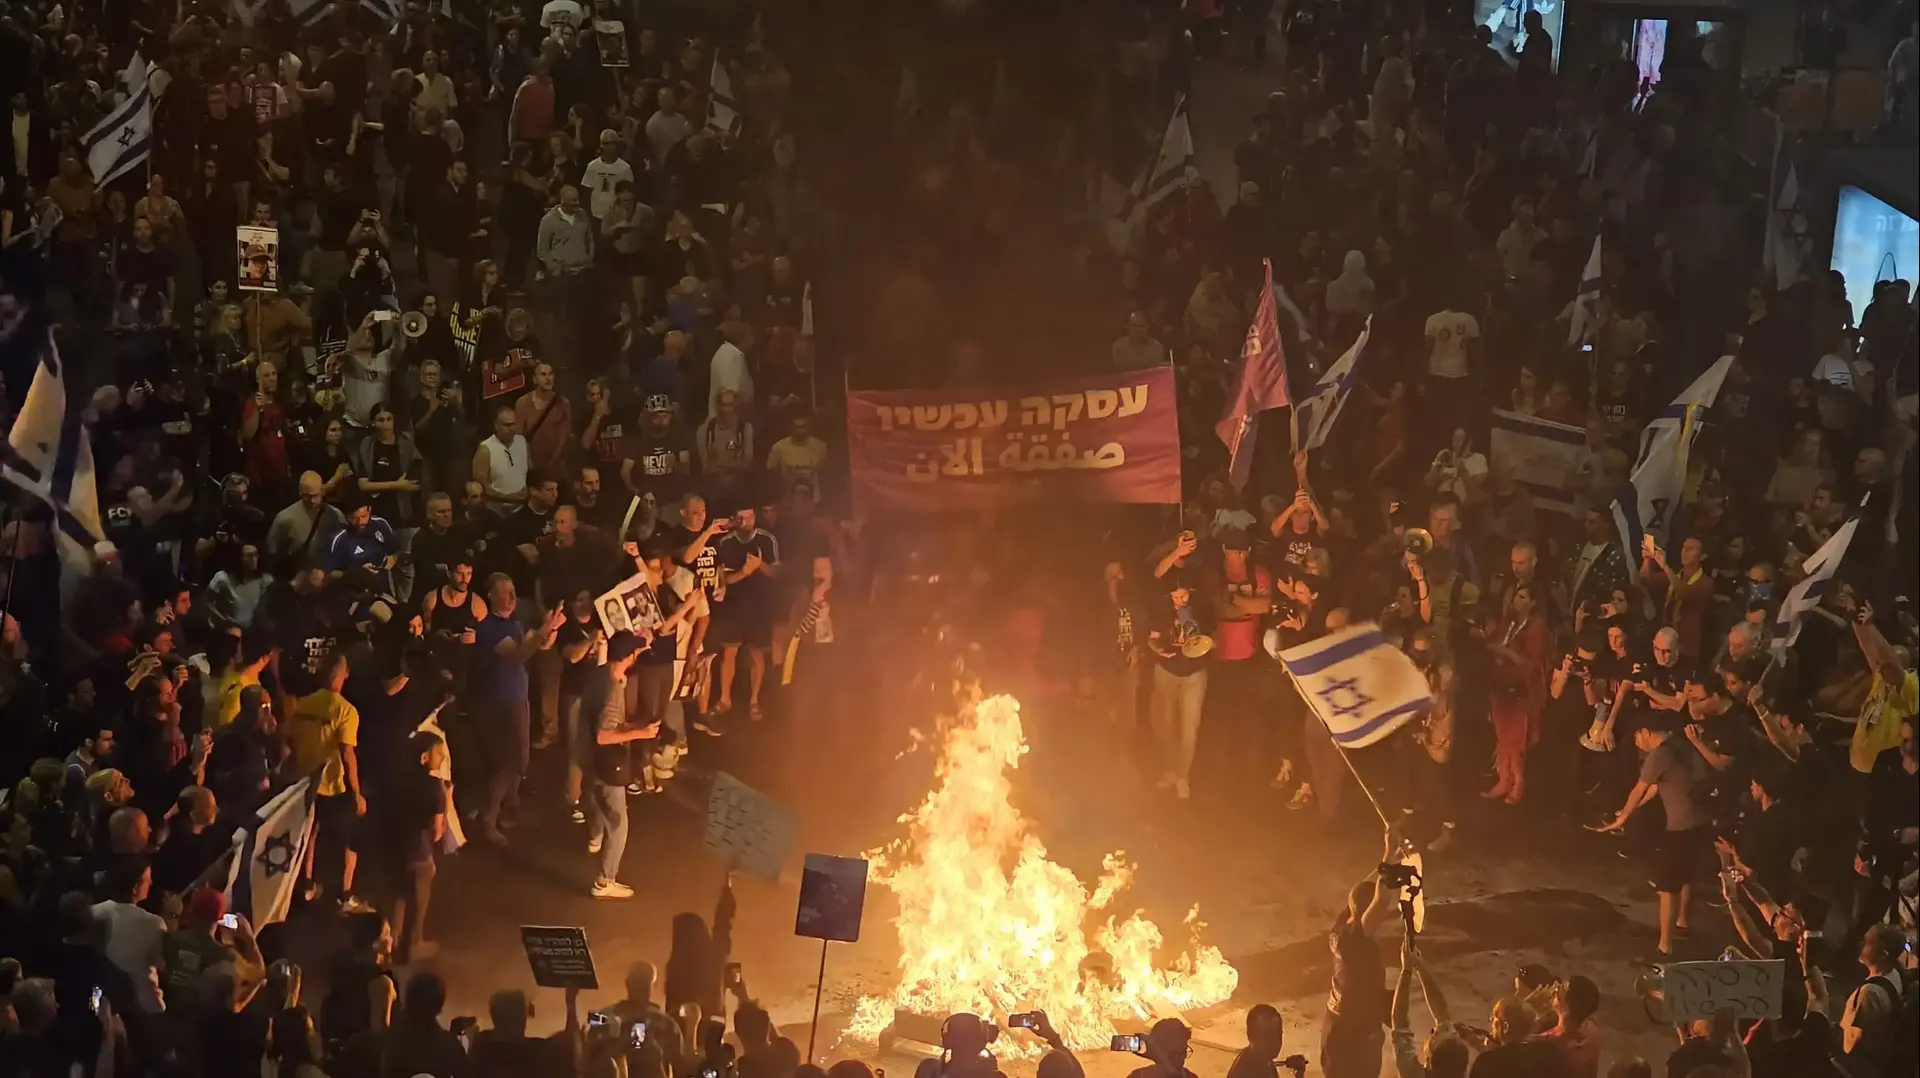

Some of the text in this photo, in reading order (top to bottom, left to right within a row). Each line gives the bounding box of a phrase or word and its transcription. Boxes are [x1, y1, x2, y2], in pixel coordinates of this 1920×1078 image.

[876, 384, 1149, 431] עסקה עכשיו
[1000, 432, 1125, 472] صفقة
